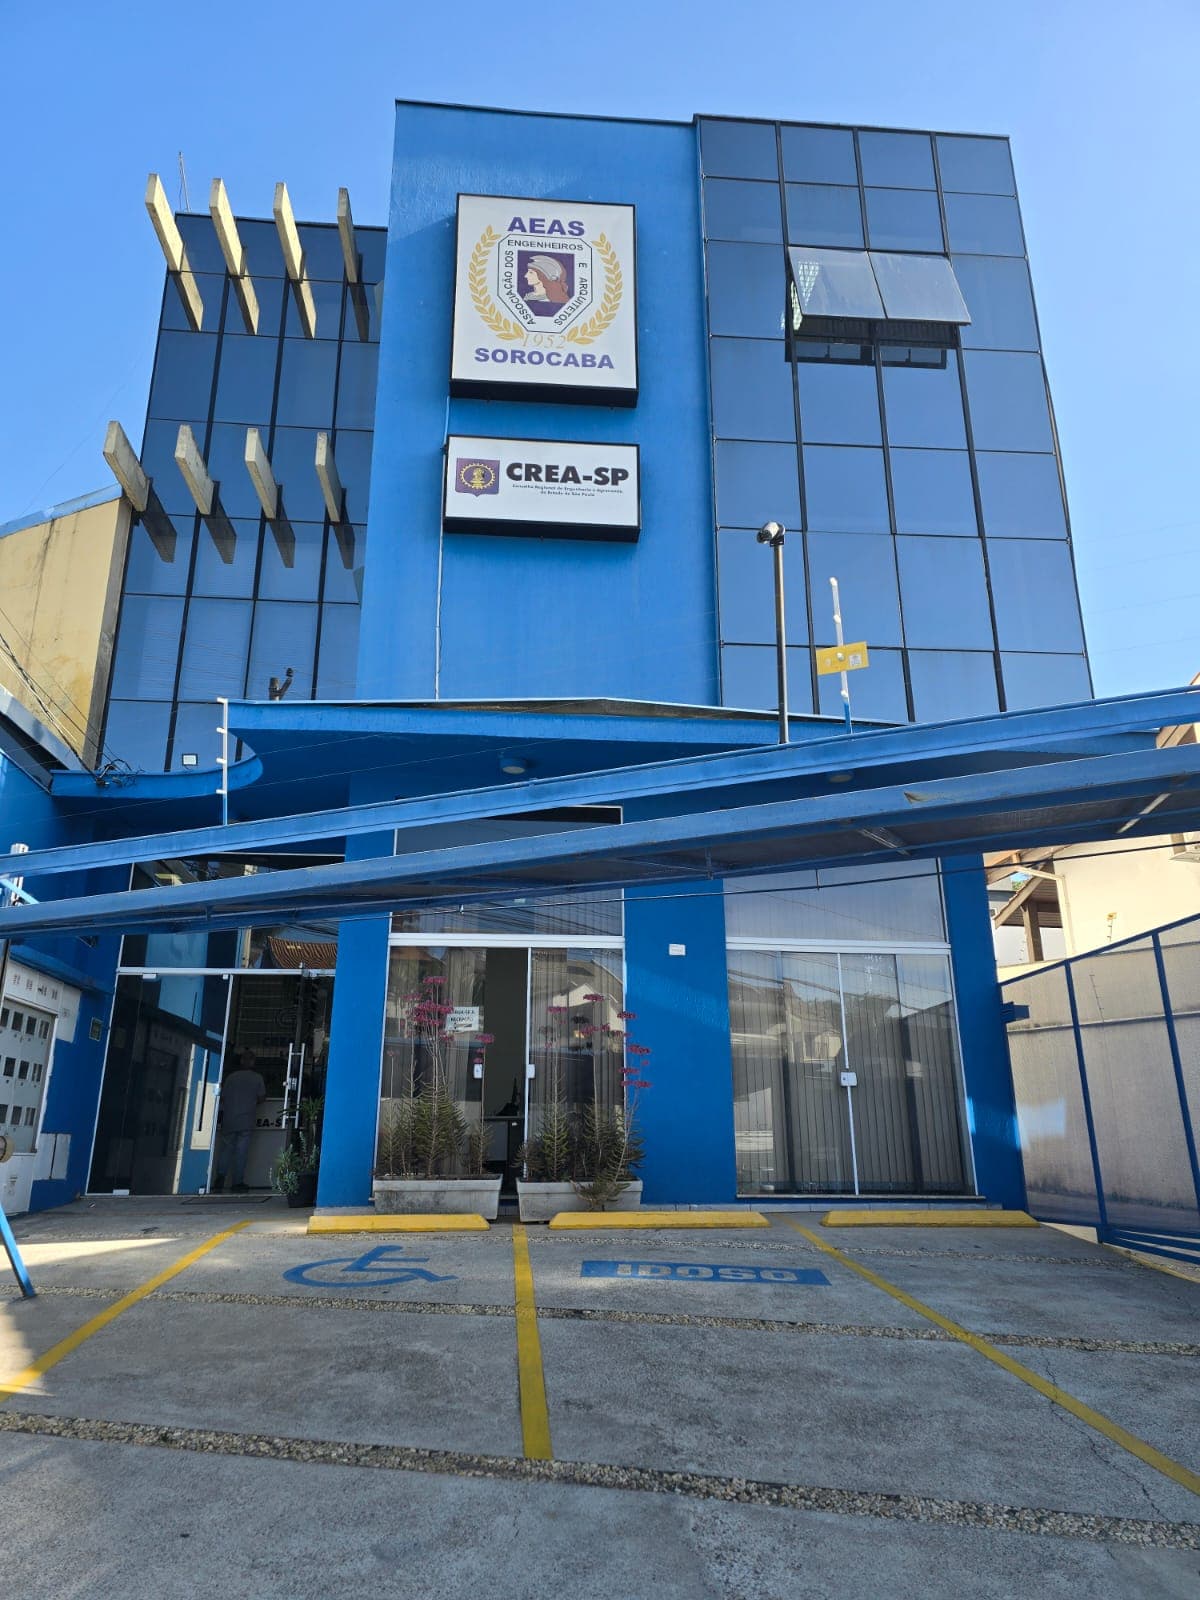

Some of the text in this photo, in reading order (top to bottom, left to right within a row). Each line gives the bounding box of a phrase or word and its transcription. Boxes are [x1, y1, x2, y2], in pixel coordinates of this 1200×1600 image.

[507, 217, 585, 236] AEAS
[507, 239, 584, 251] ENGENHEIROS
[504, 250, 514, 268] DOS
[553, 277, 589, 326] ARQUITETOS
[521, 333, 566, 349] 1952
[474, 347, 615, 369] SOROCABA
[506, 462, 629, 486] CREA-SP
[617, 1263, 798, 1281] IDOSO
